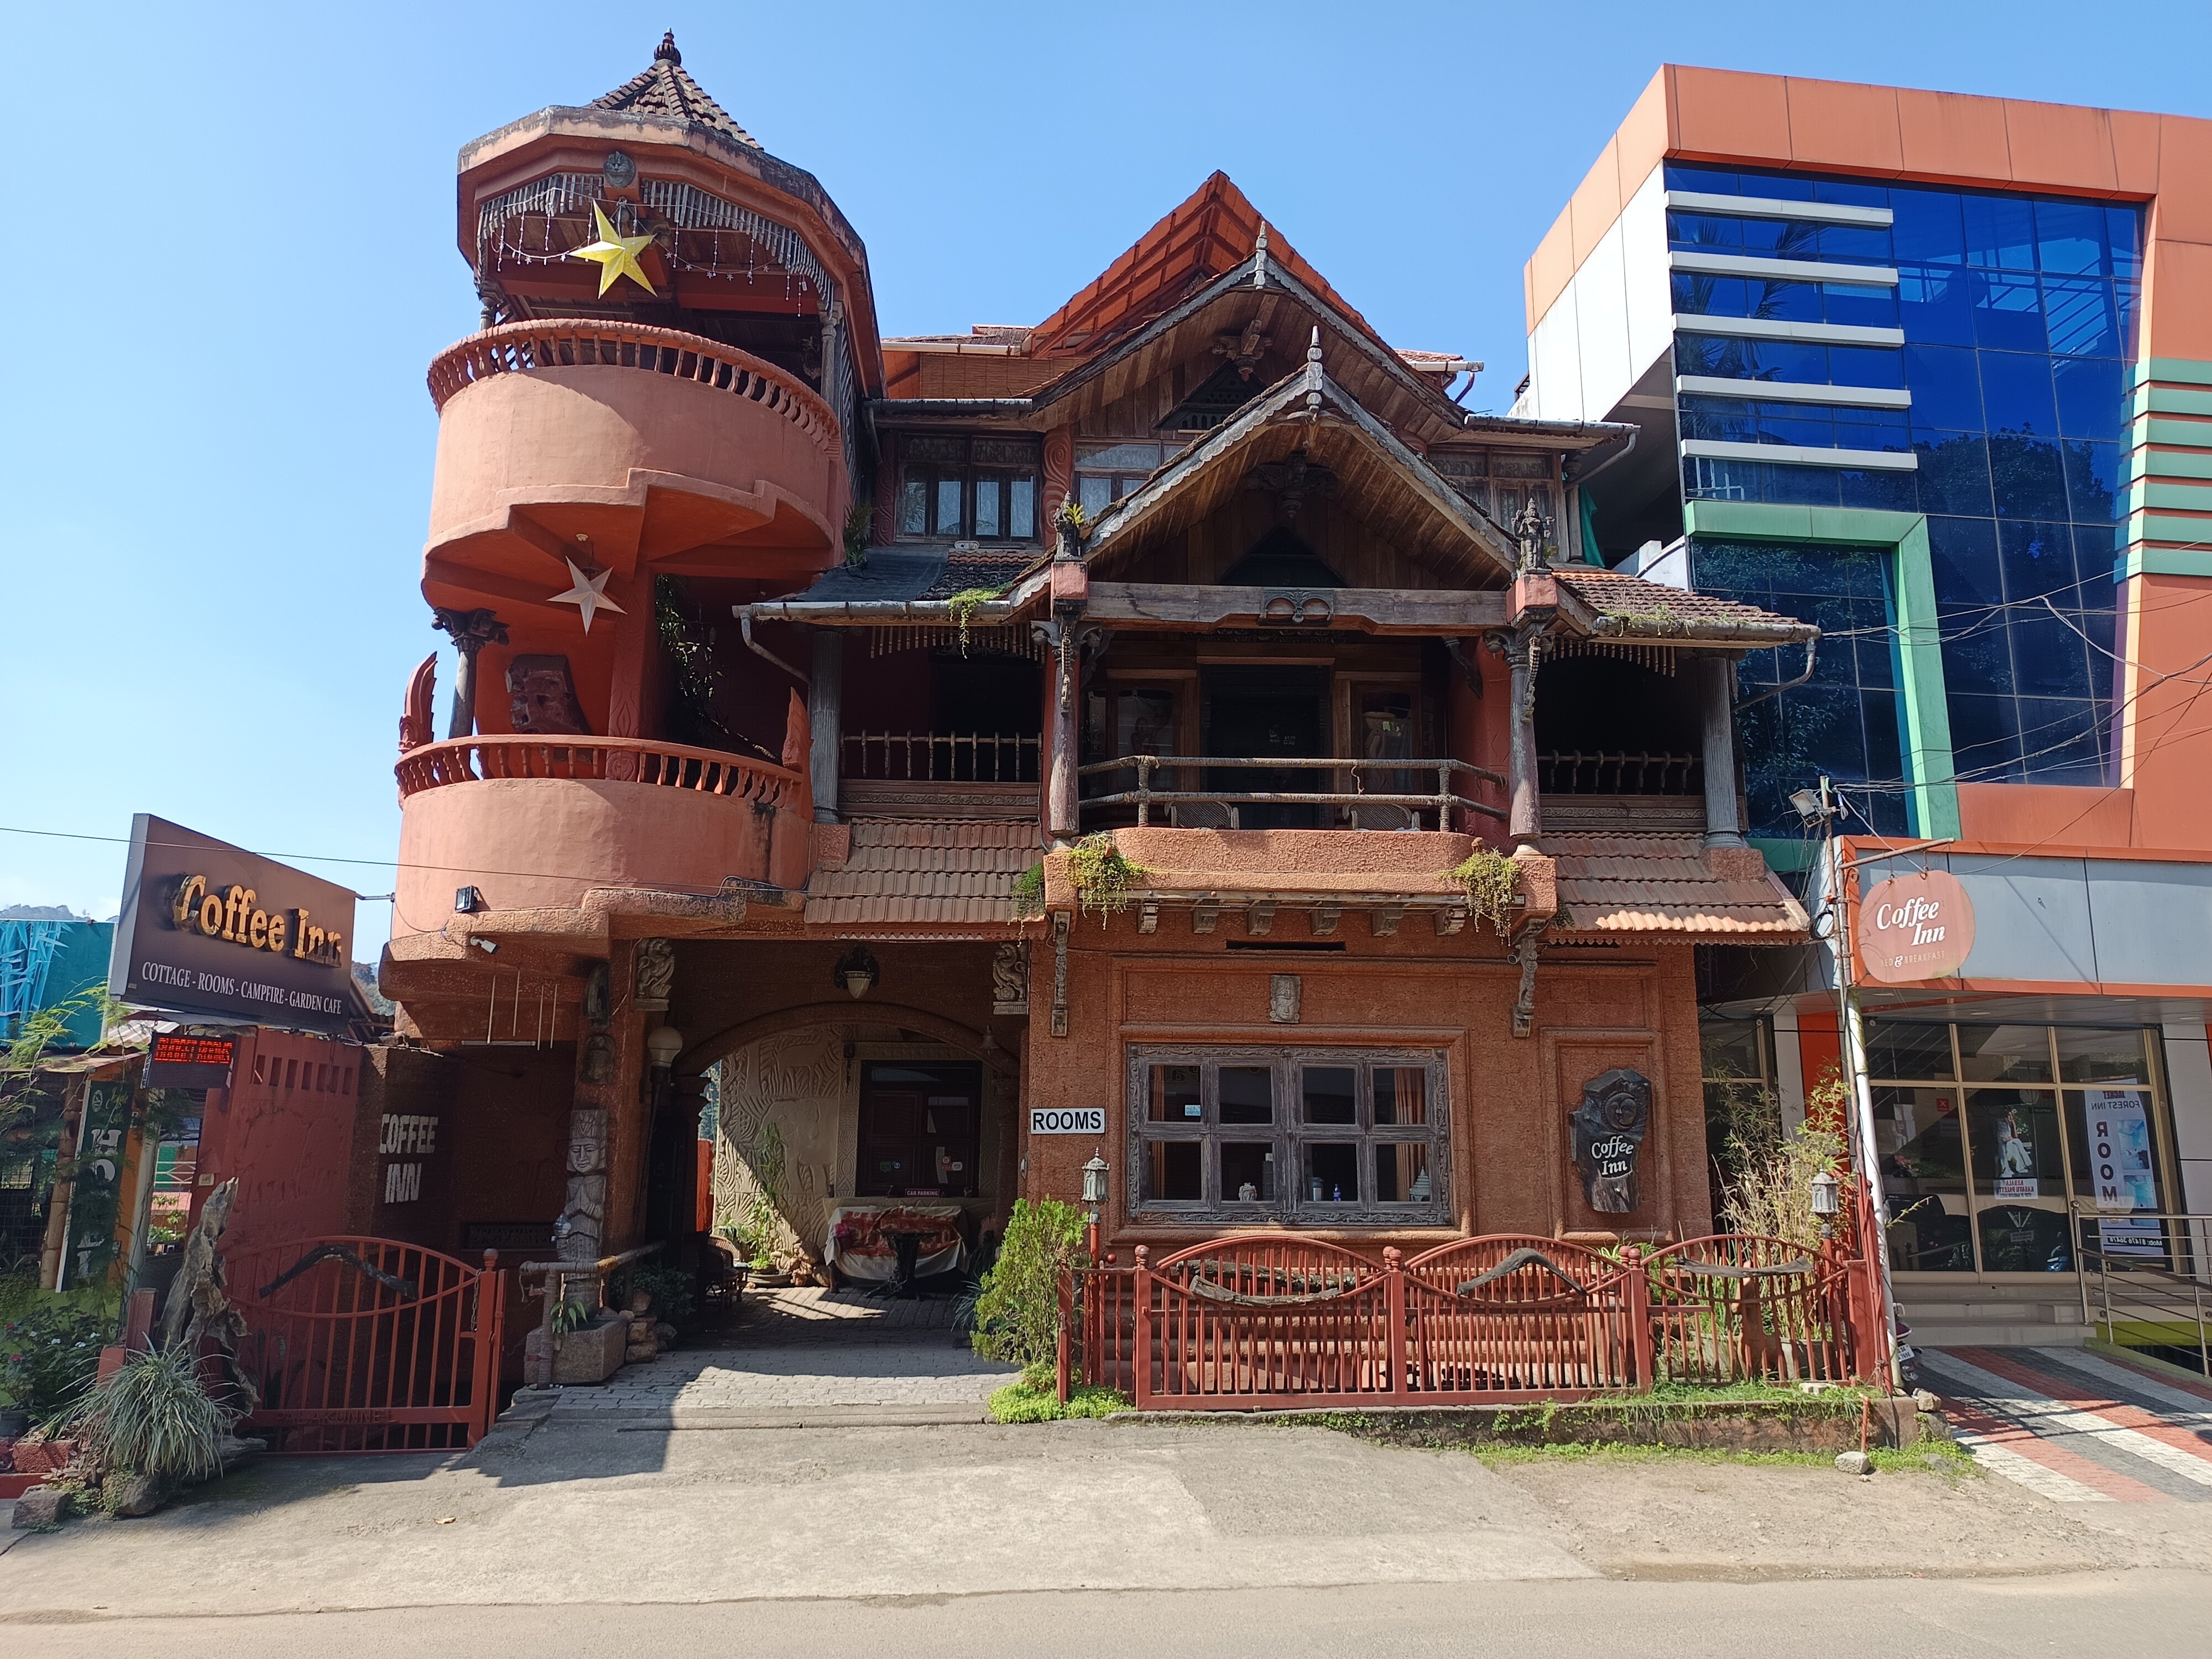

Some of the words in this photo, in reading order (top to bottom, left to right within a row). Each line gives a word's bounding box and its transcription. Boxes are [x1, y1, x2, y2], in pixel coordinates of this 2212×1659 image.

[175, 874, 285, 952] Coffee
[292, 908, 342, 967] Inn
[1876, 896, 1939, 930] Coffee
[1911, 922, 1945, 946] Inn
[1894, 955, 1903, 968] &
[1904, 950, 1945, 964] BREAKFAST
[142, 961, 191, 988] COTTAGE
[197, 972, 234, 995] ROOMS
[241, 981, 285, 1004] CAMPFIRE
[289, 990, 322, 1011] GARDEN
[324, 997, 342, 1014] CAFE
[379, 1114, 439, 1154] COFFEE
[1032, 1110, 1102, 1131] ROOMS
[1592, 1135, 1634, 1159] Coffee
[1601, 1160, 1627, 1175] Inn
[384, 1162, 422, 1203] INN
